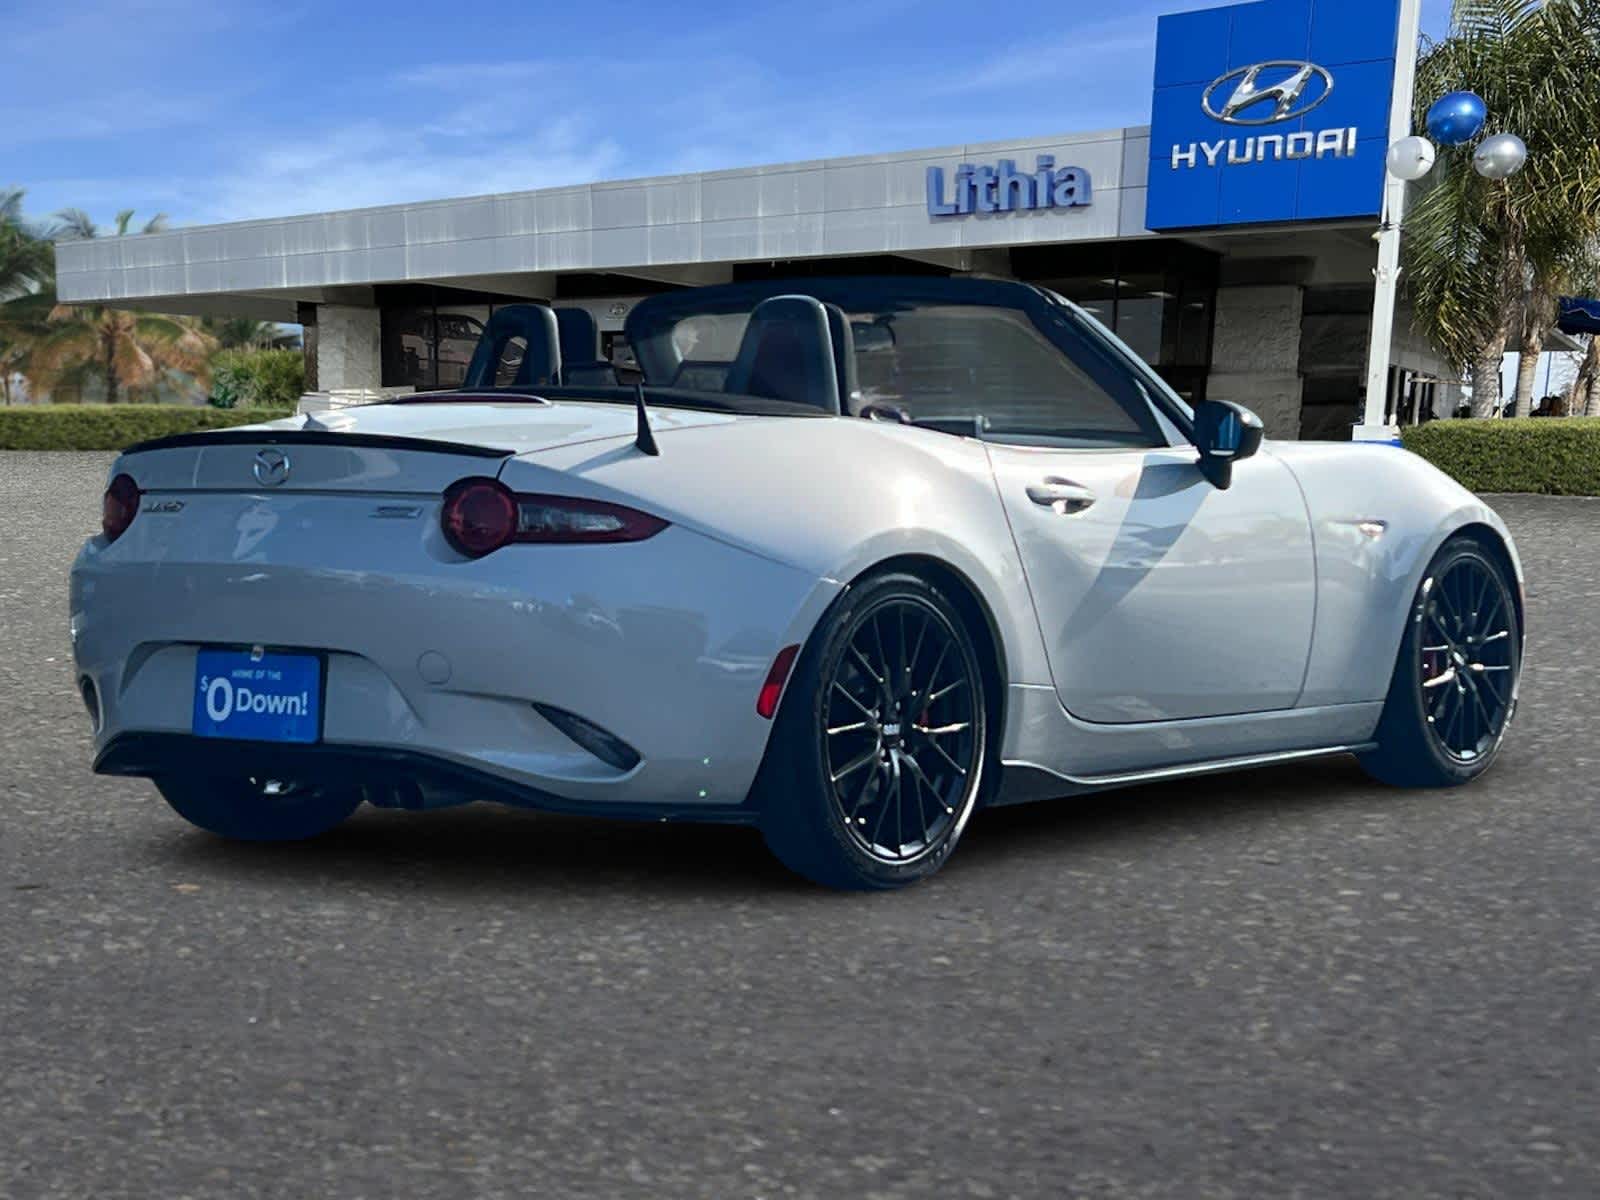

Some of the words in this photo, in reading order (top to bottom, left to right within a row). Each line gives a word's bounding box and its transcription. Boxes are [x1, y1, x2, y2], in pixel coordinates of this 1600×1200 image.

[1171, 127, 1357, 169] HYUNDAI
[926, 154, 1092, 216] Lithia
[236, 687, 308, 716] Down!
